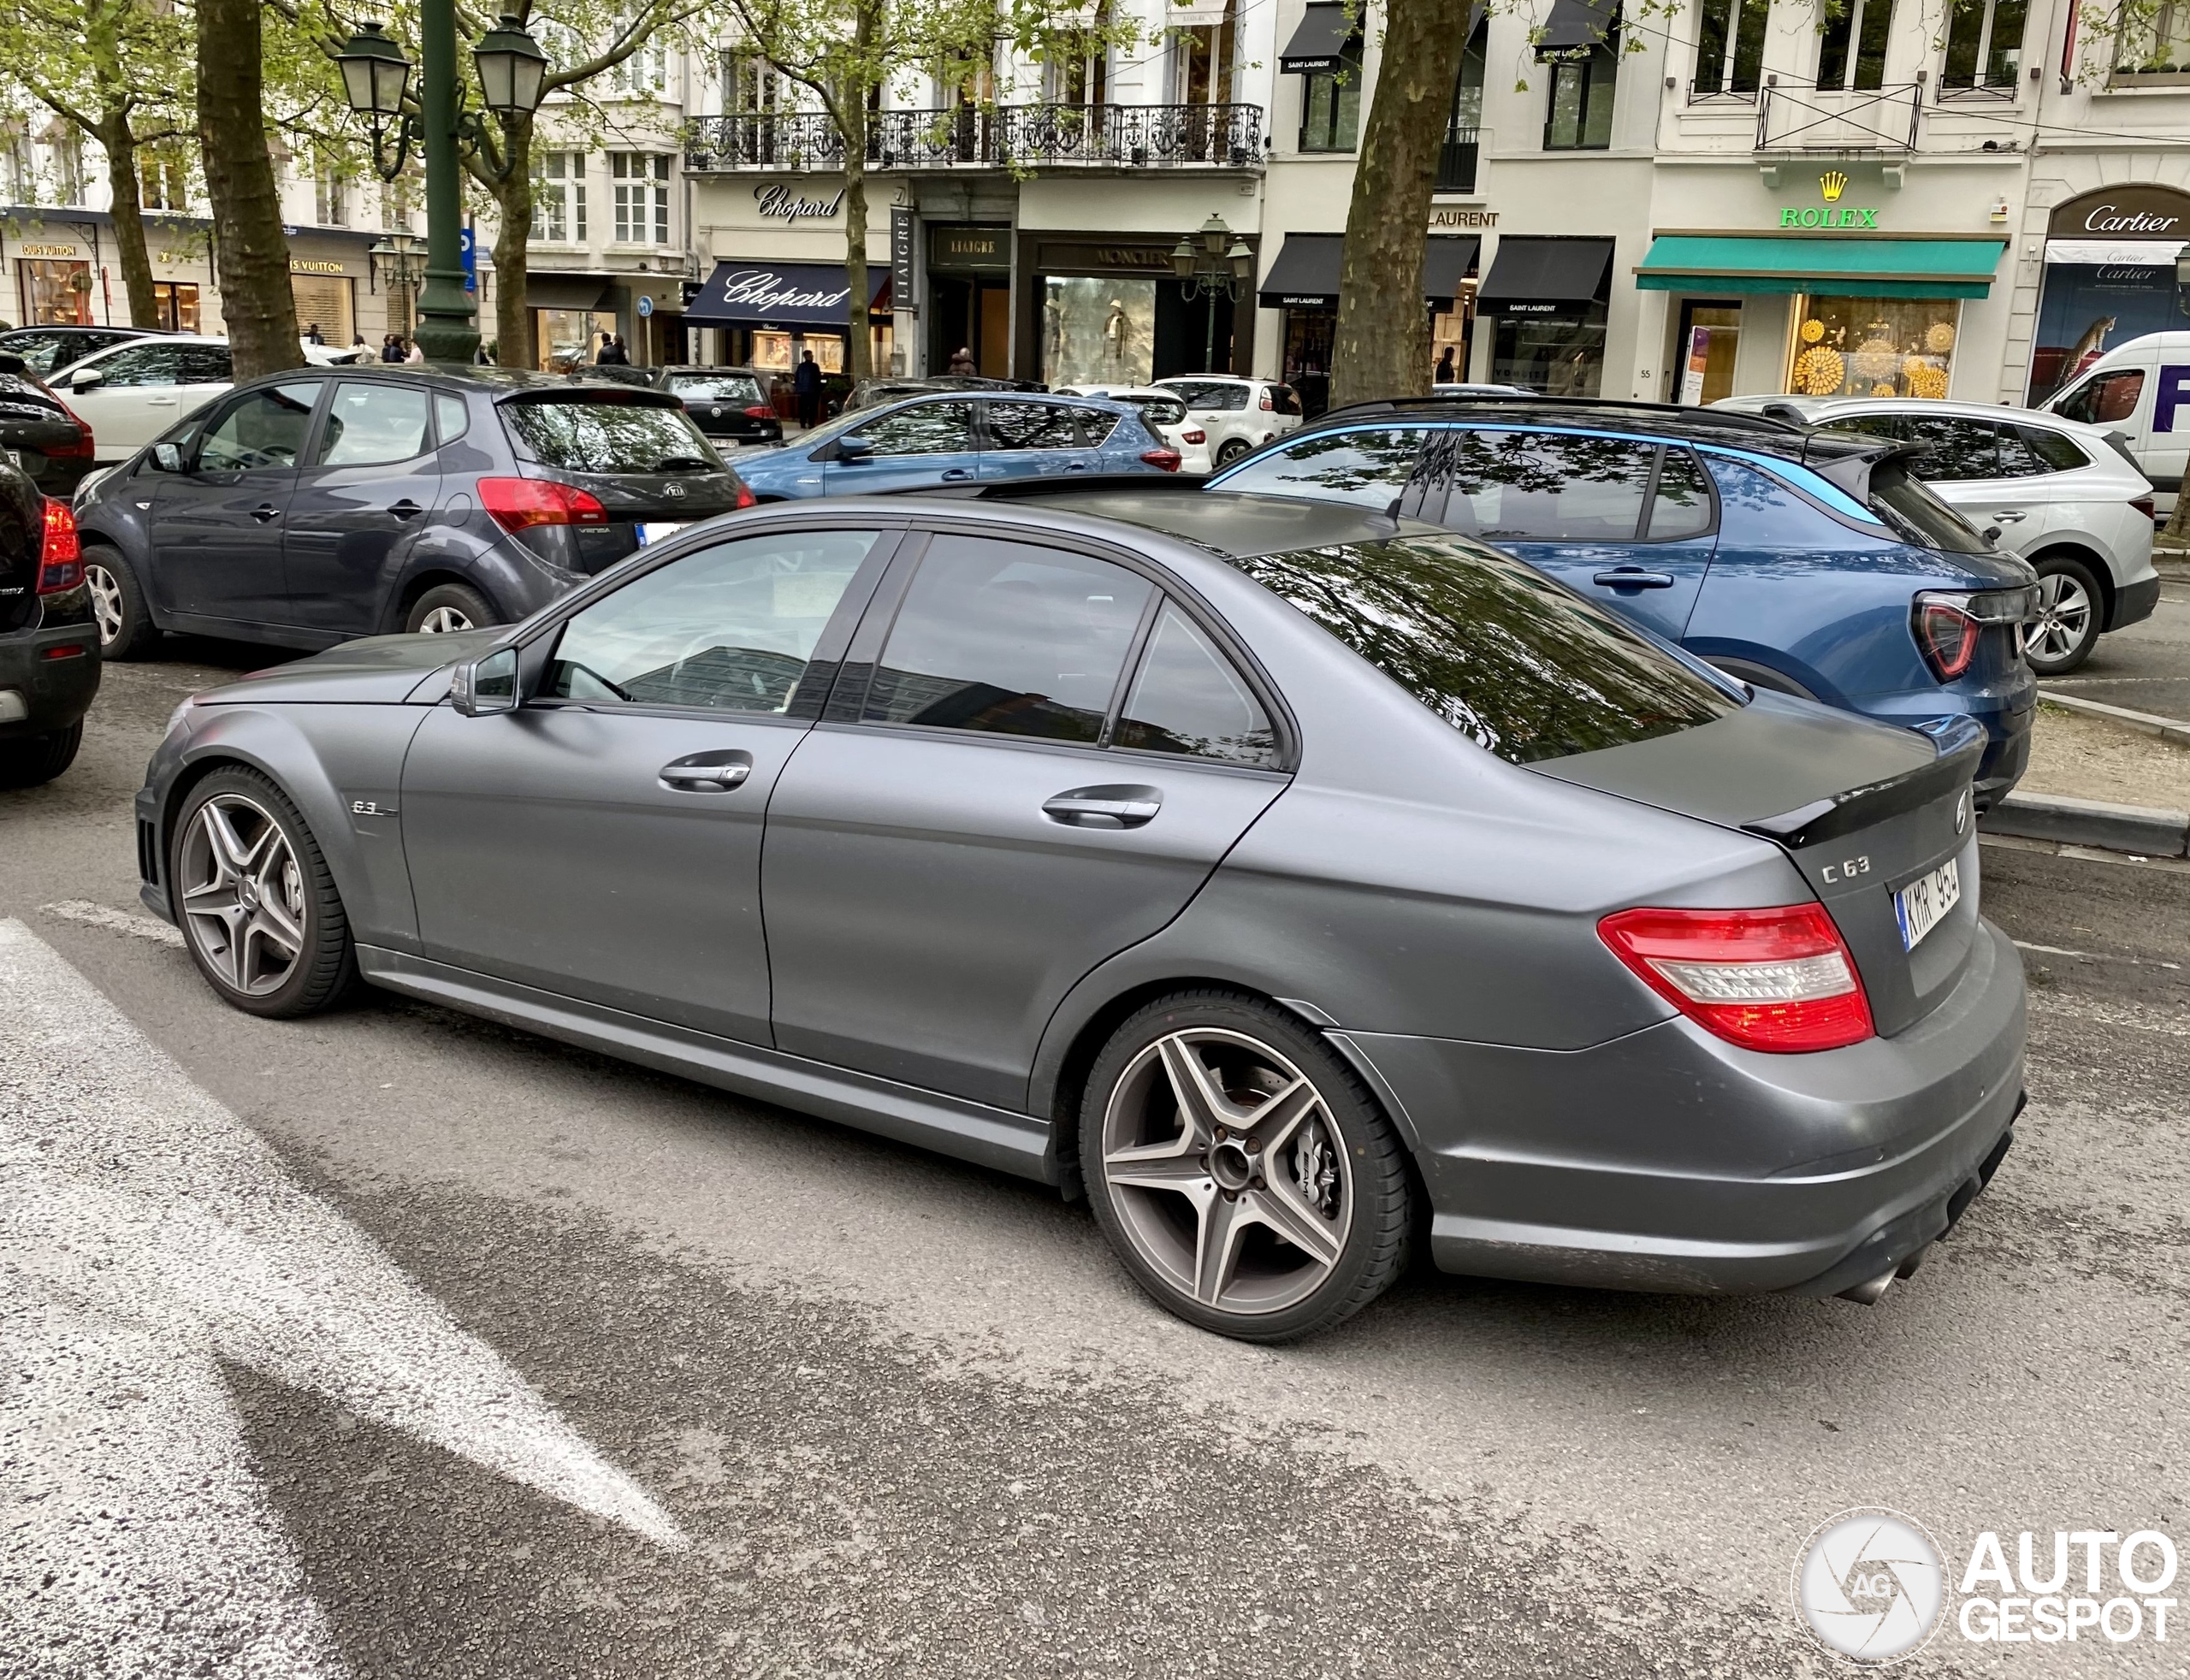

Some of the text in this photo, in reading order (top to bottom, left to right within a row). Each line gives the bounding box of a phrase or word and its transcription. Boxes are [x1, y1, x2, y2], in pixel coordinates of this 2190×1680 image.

[754, 183, 845, 223] Chopard
[1779, 207, 1879, 228] ROLEX
[2085, 205, 2180, 231] Cartier
[21, 245, 75, 256] LOUIS VUITTON
[950, 241, 995, 253] LIAIGRE
[2107, 251, 2146, 262] Cartier
[301, 261, 343, 272] VUITTON
[897, 217, 909, 299] LIAIGRE
[2097, 264, 2157, 280] Cartier
[724, 270, 851, 312] Chopard
[1641, 370, 1650, 378] 55
[1822, 855, 1871, 884] C 63
[1905, 861, 1958, 940] KMR 954
